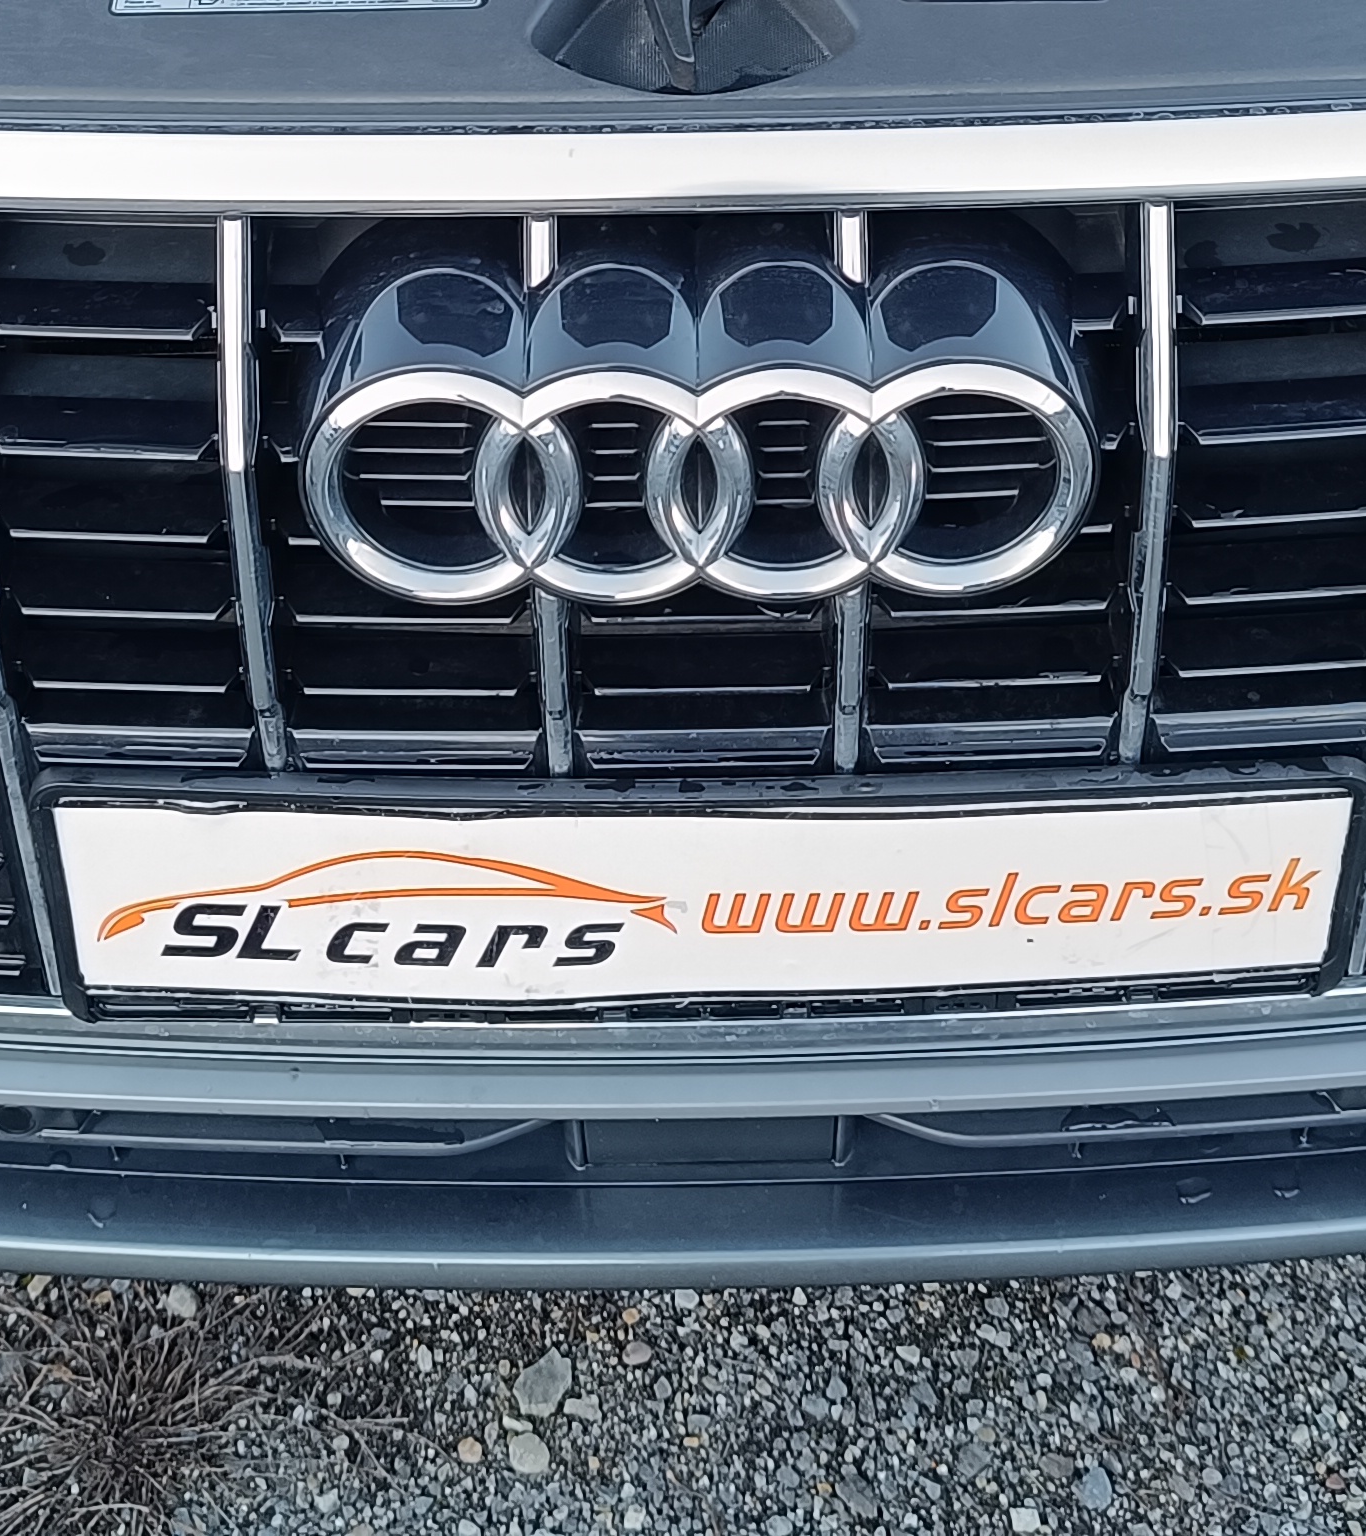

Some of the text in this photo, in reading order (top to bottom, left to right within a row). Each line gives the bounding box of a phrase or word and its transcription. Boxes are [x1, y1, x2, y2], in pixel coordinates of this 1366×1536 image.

[700, 857, 1323, 935] www.slcars.sk
[160, 902, 626, 968] SL cars
